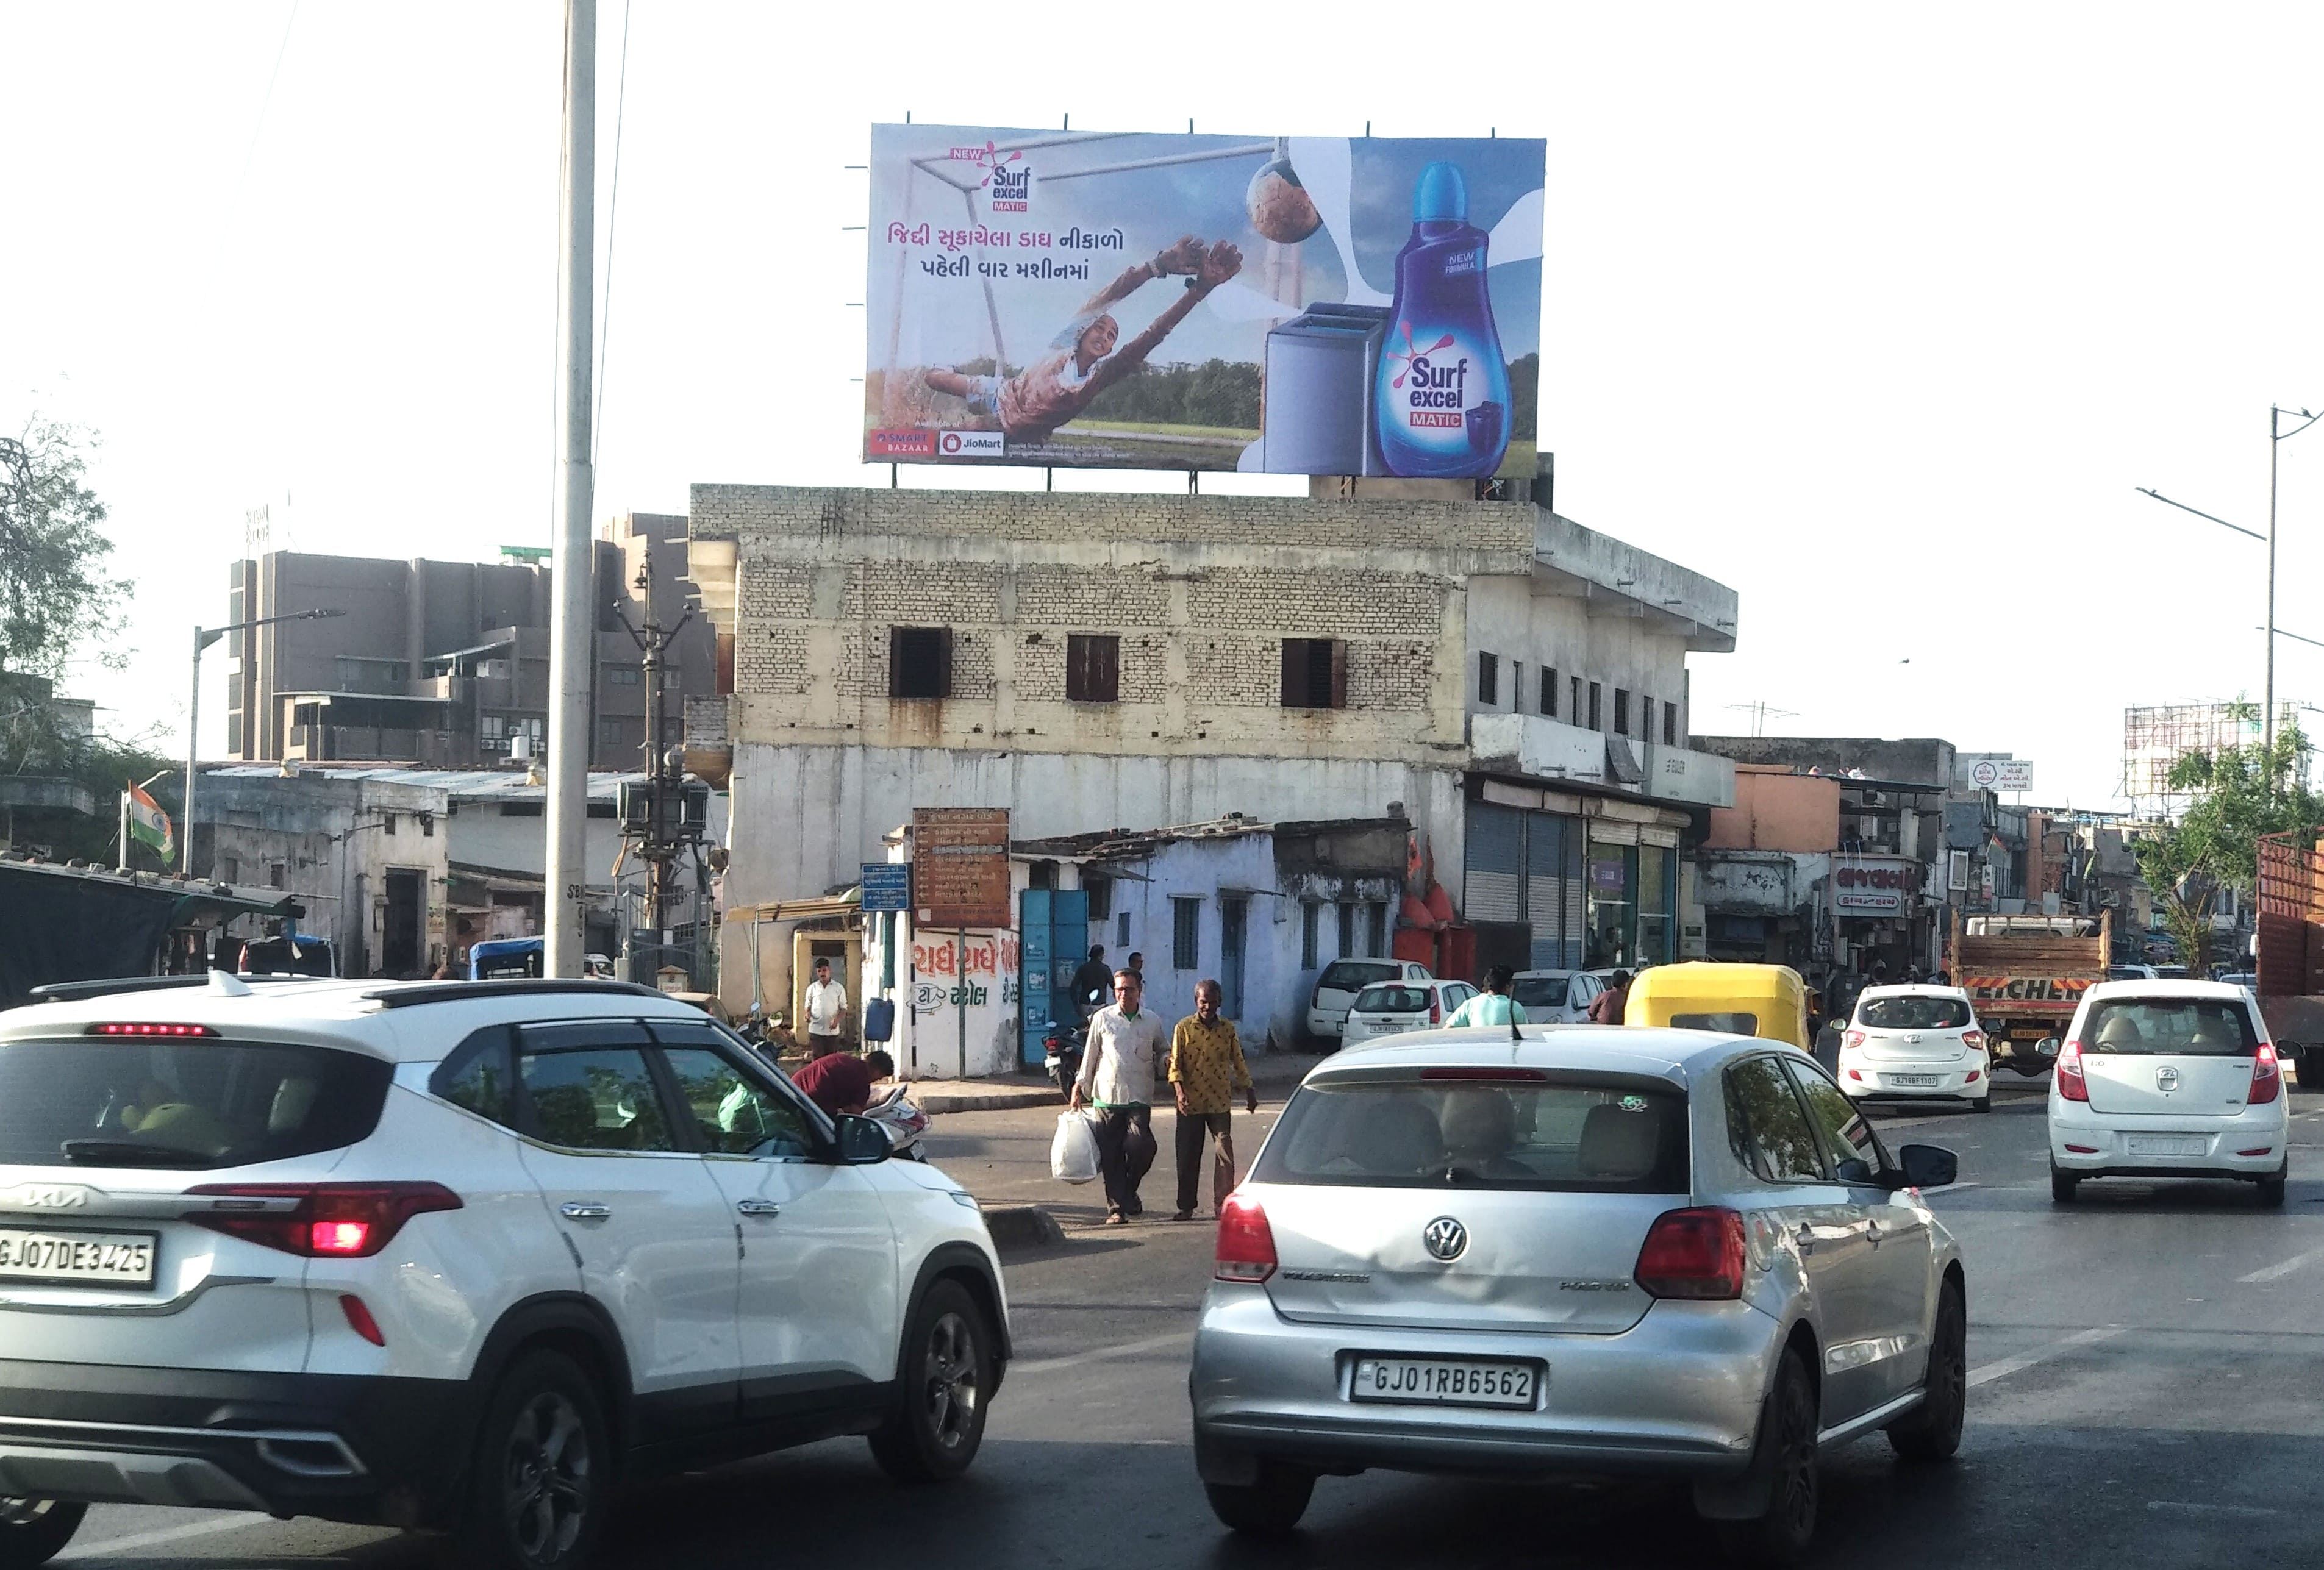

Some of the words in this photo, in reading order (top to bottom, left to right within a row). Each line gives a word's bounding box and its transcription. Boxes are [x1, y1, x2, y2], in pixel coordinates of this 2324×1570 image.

[953, 149, 982, 160] NEW
[994, 166, 1031, 186] Surf
[993, 185, 1028, 200] excel
[993, 202, 1027, 212] MATIC
[888, 221, 930, 245] જિદ્દી
[938, 224, 1010, 252] સૂકાયેલા
[1019, 231, 1051, 247] ડાઘ
[1059, 227, 1123, 251] નીકાળો
[921, 254, 970, 277] પહેલી
[978, 262, 1009, 278] વાર
[1017, 257, 1089, 280] મશીનમાં
[1449, 252, 1475, 263] NEW
[1412, 357, 1467, 388] Surf
[1410, 388, 1463, 409] excel
[1412, 413, 1461, 427] MATIC
[887, 444, 928, 452] BAZAAR
[889, 433, 928, 443] SMART
[964, 438, 1001, 449] JioMart
[915, 940, 956, 976] રાધે
[23, 1188, 88, 1208] KIA
[0, 1239, 149, 1272] GJ07DE3425
[1375, 1366, 1529, 1397] GJ01RB6562
